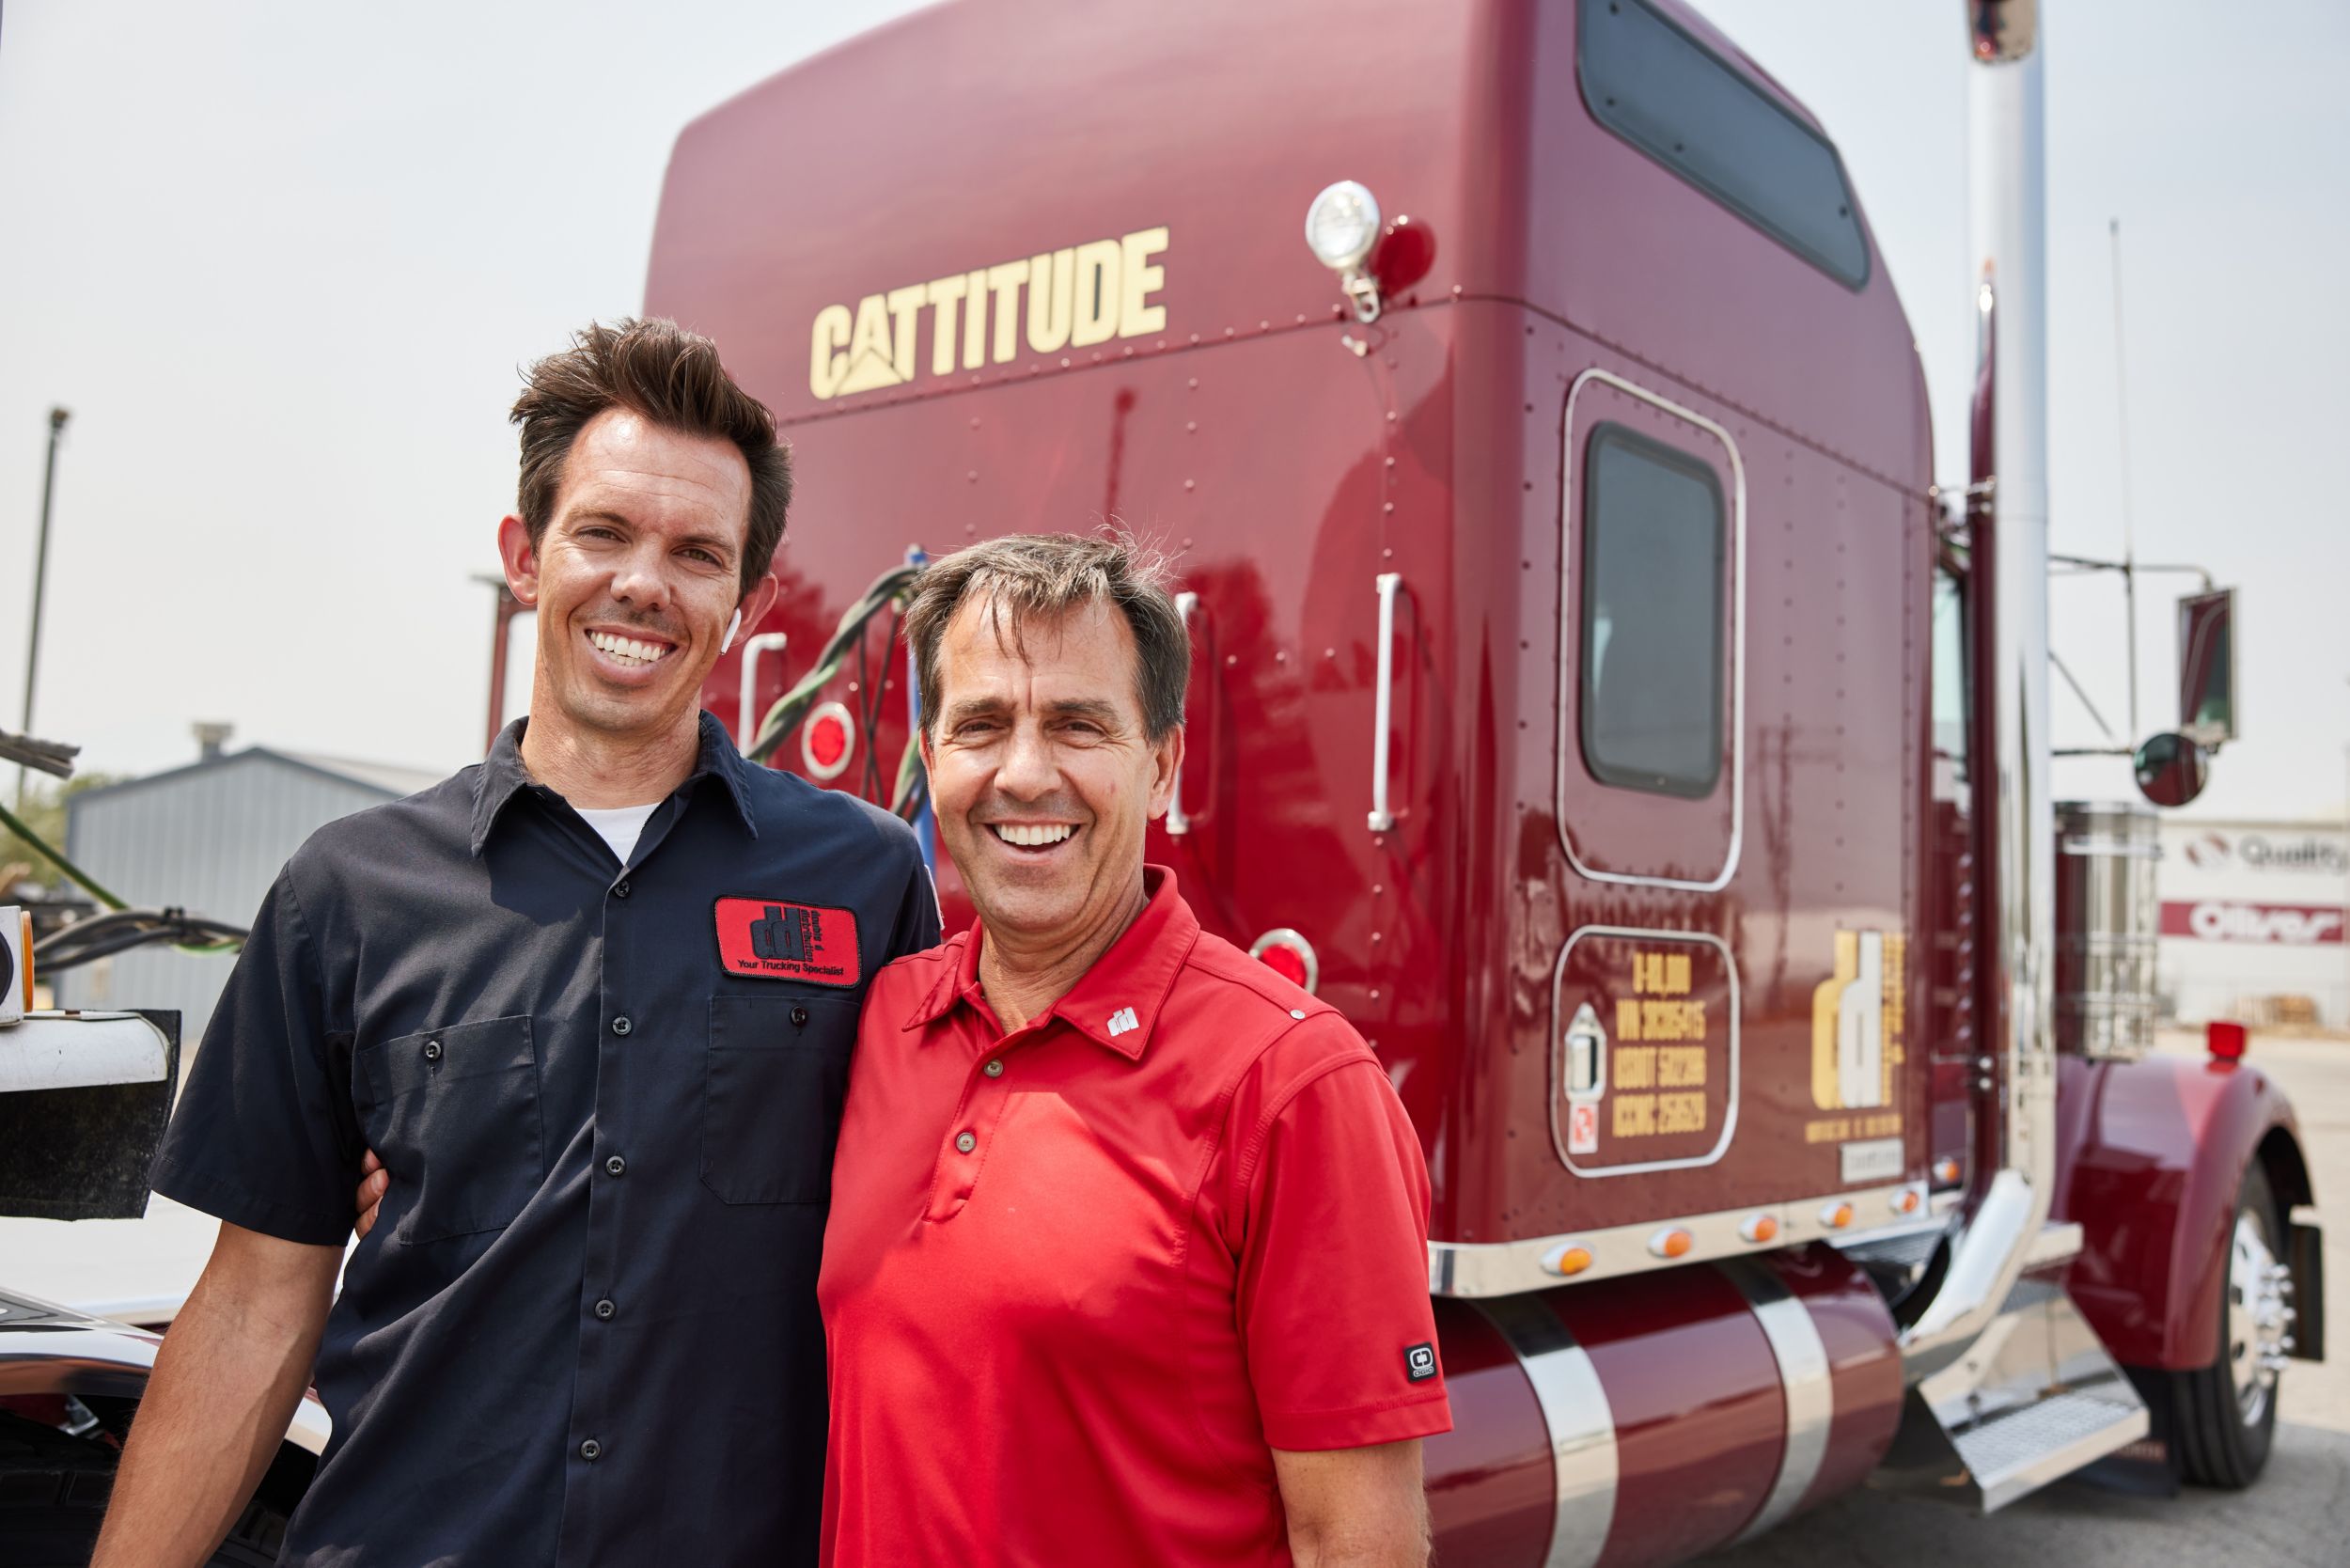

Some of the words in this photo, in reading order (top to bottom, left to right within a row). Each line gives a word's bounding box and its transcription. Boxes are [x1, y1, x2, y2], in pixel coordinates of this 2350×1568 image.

[810, 226, 1168, 400] CATTITUDE
[738, 960, 759, 969] Your
[761, 960, 801, 972] Trucking
[802, 963, 844, 976] Specialist
